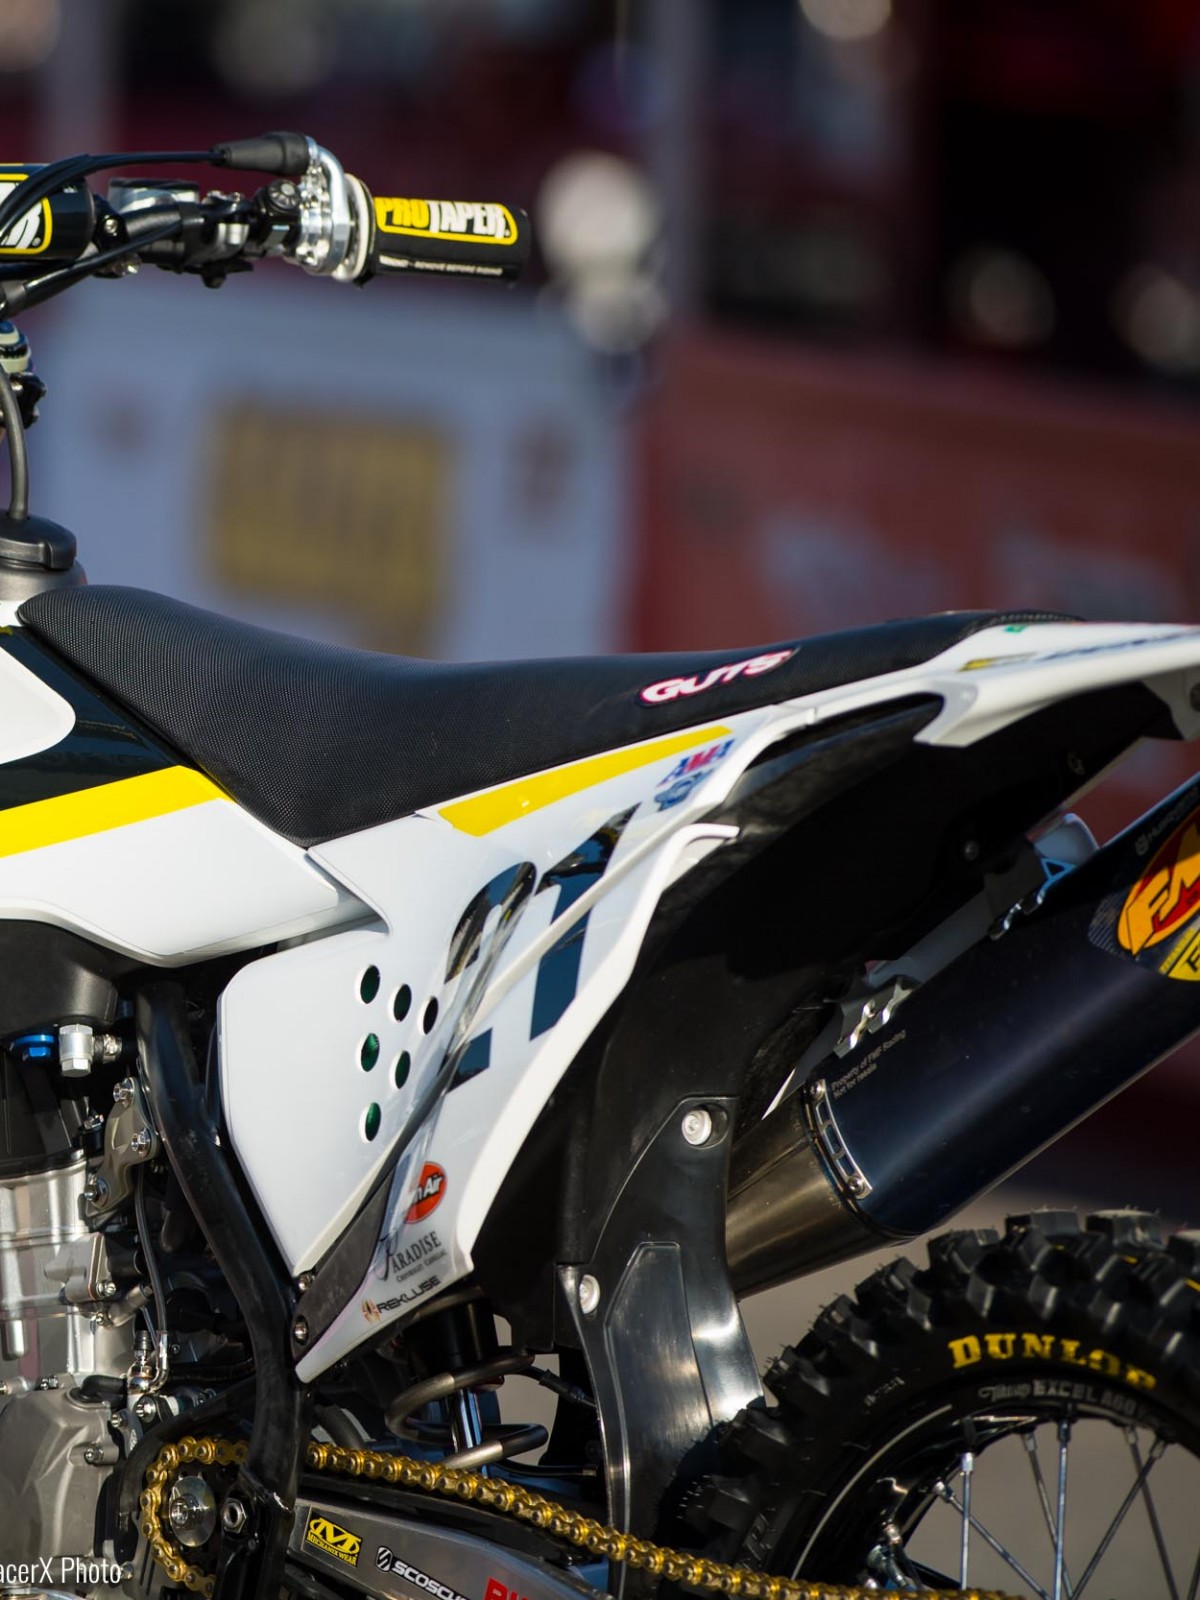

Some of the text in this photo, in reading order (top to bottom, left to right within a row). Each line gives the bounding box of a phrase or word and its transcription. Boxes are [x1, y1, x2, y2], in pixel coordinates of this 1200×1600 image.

[641, 650, 794, 702] GUTS
[377, 1275, 442, 1313] REKLUSE
[307, 1530, 357, 1567] MECHANIX WEAR
